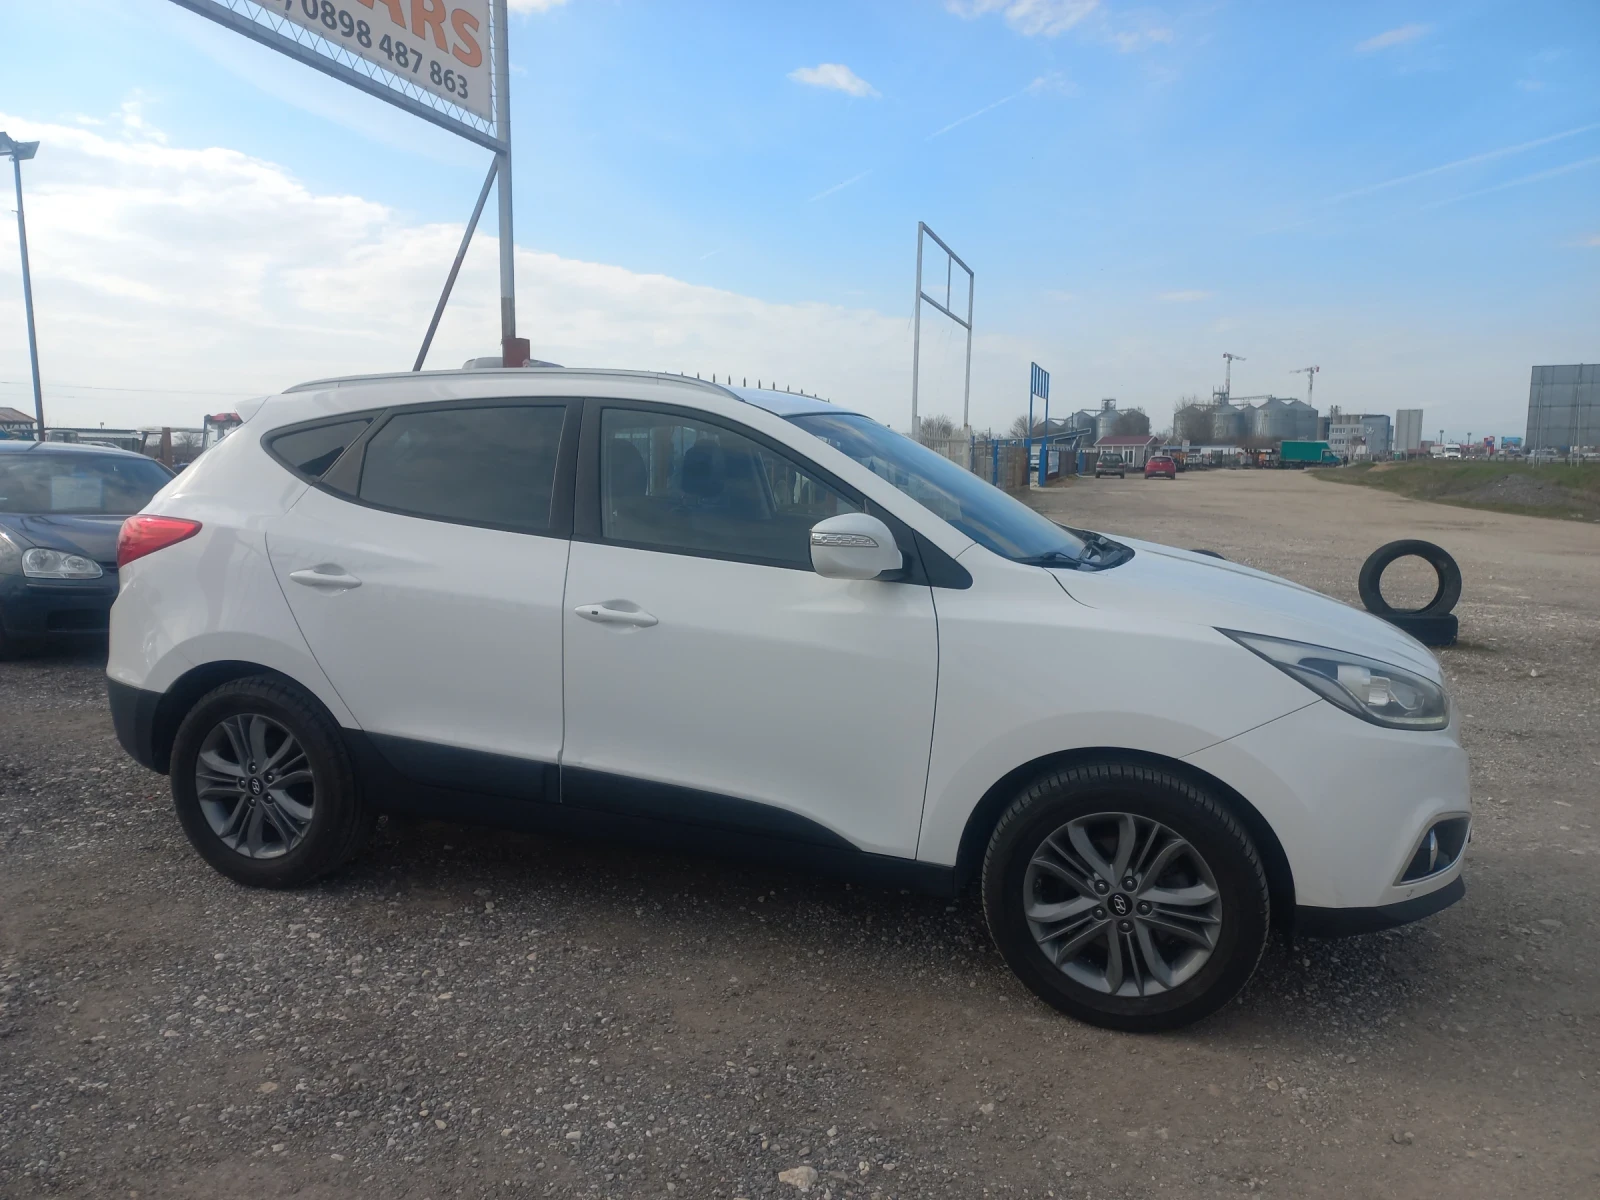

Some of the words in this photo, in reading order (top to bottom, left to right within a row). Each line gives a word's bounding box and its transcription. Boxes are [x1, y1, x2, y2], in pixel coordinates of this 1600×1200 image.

[301, 0, 372, 48] 0898
[378, 33, 423, 74] 487
[429, 60, 469, 99] 863
